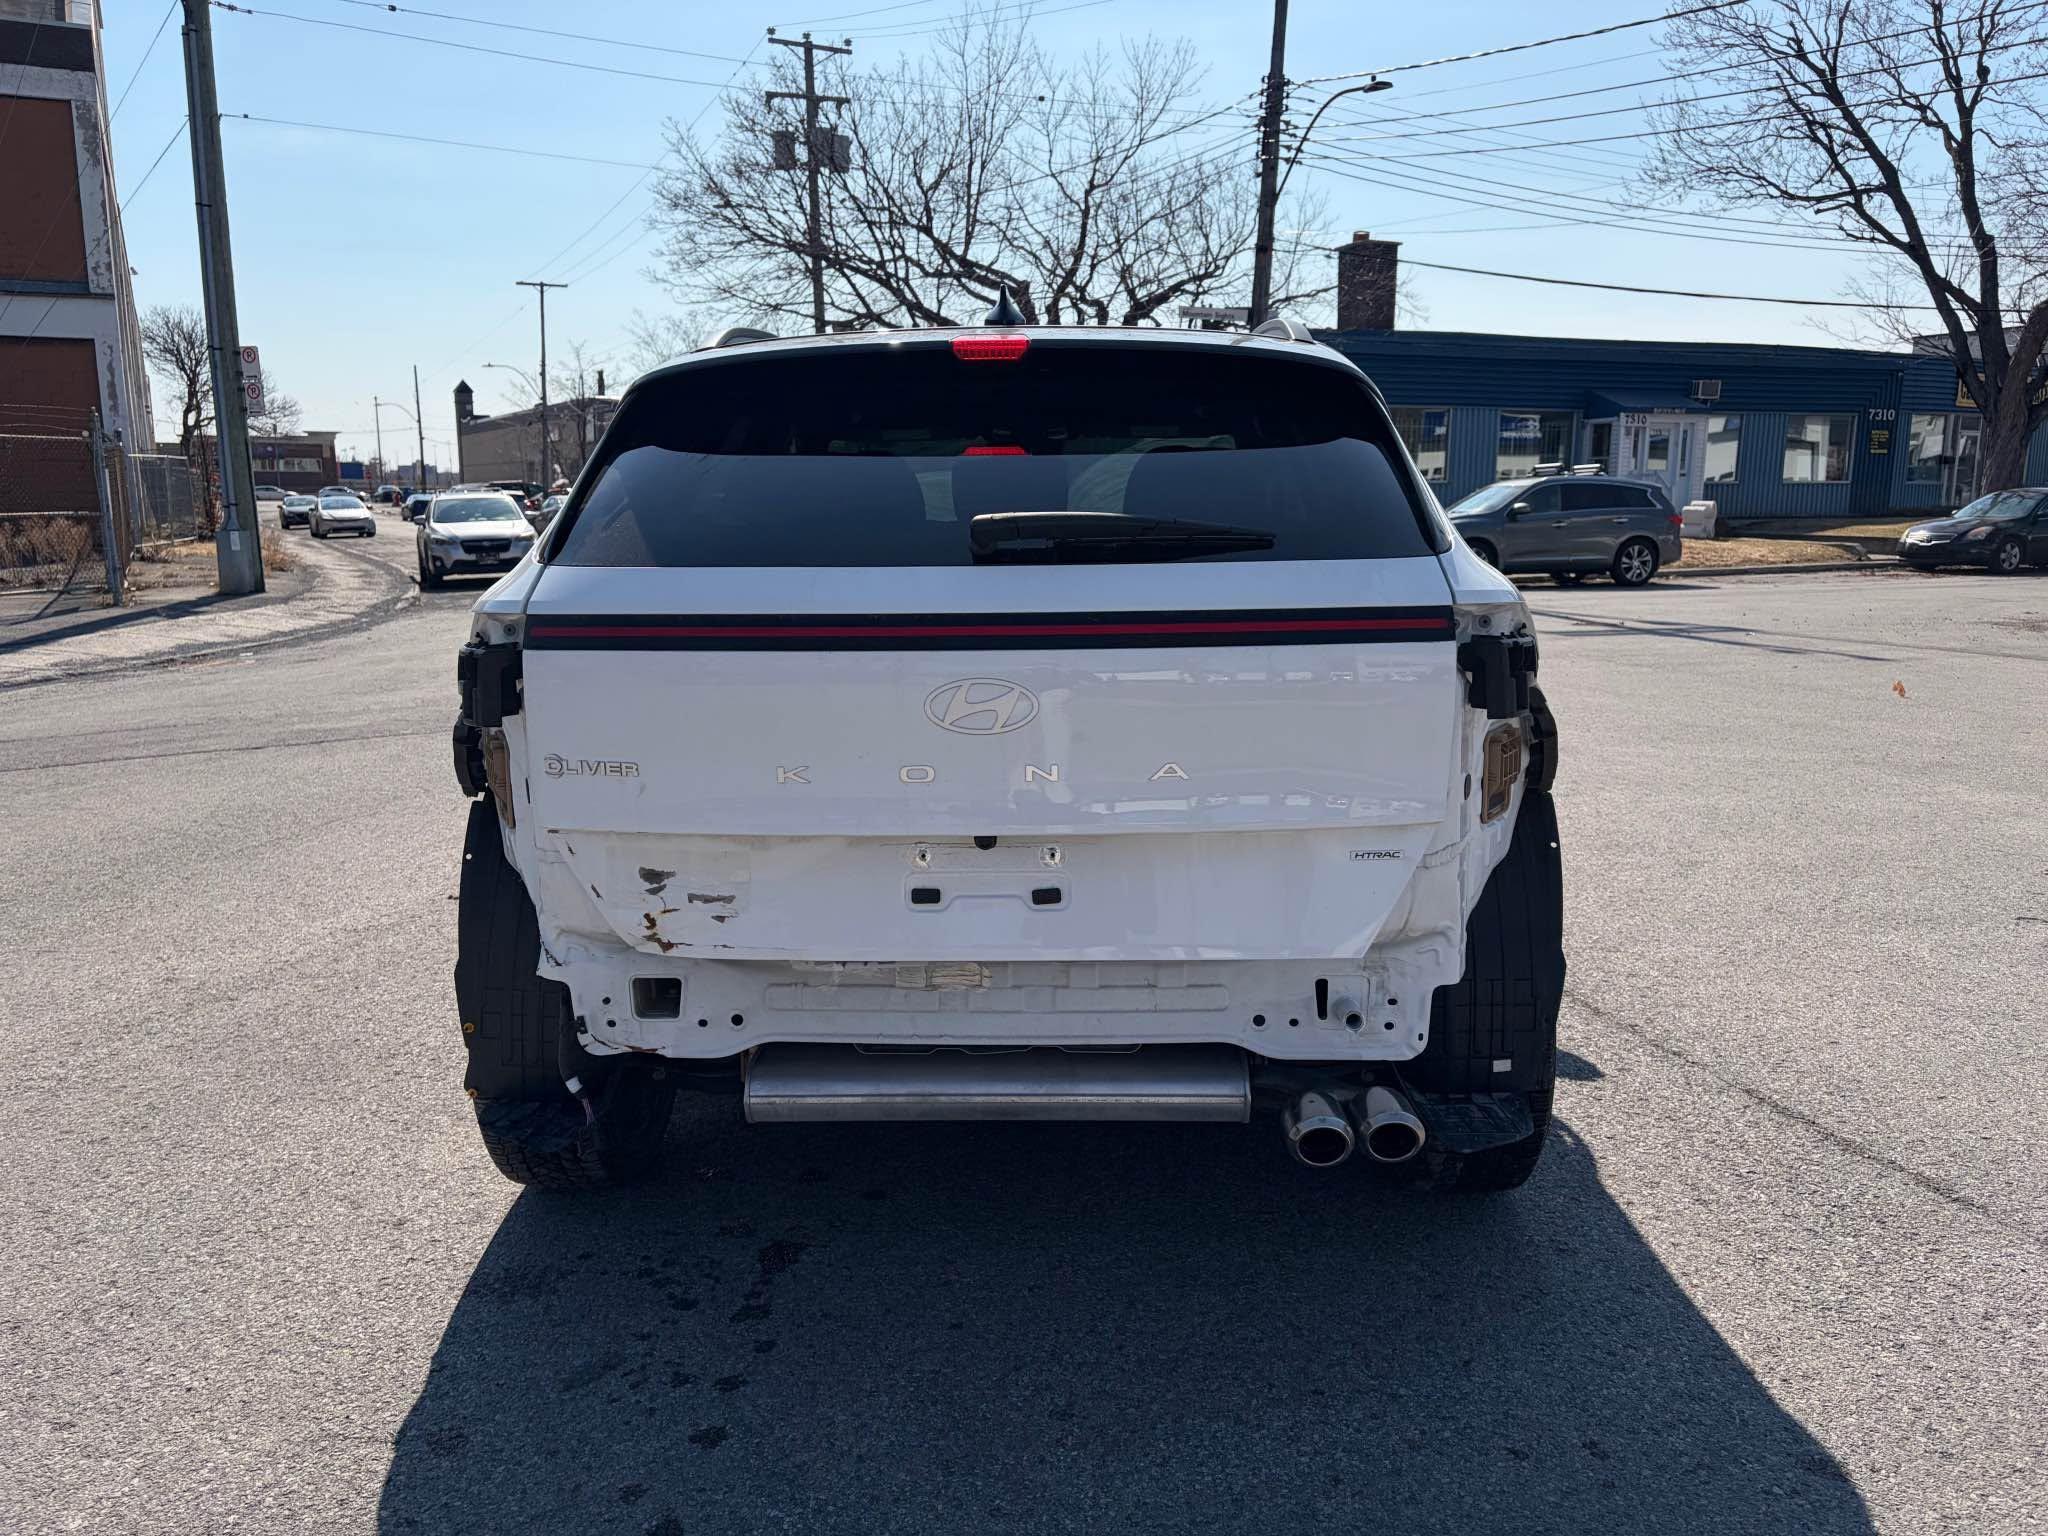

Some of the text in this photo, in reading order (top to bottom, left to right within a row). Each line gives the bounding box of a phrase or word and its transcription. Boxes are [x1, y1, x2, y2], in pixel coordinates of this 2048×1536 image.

[1868, 408, 1896, 421] 7310
[544, 753, 640, 779] OLIVIER
[776, 762, 1190, 784] KONA
[1354, 851, 1401, 859] HTRAC
